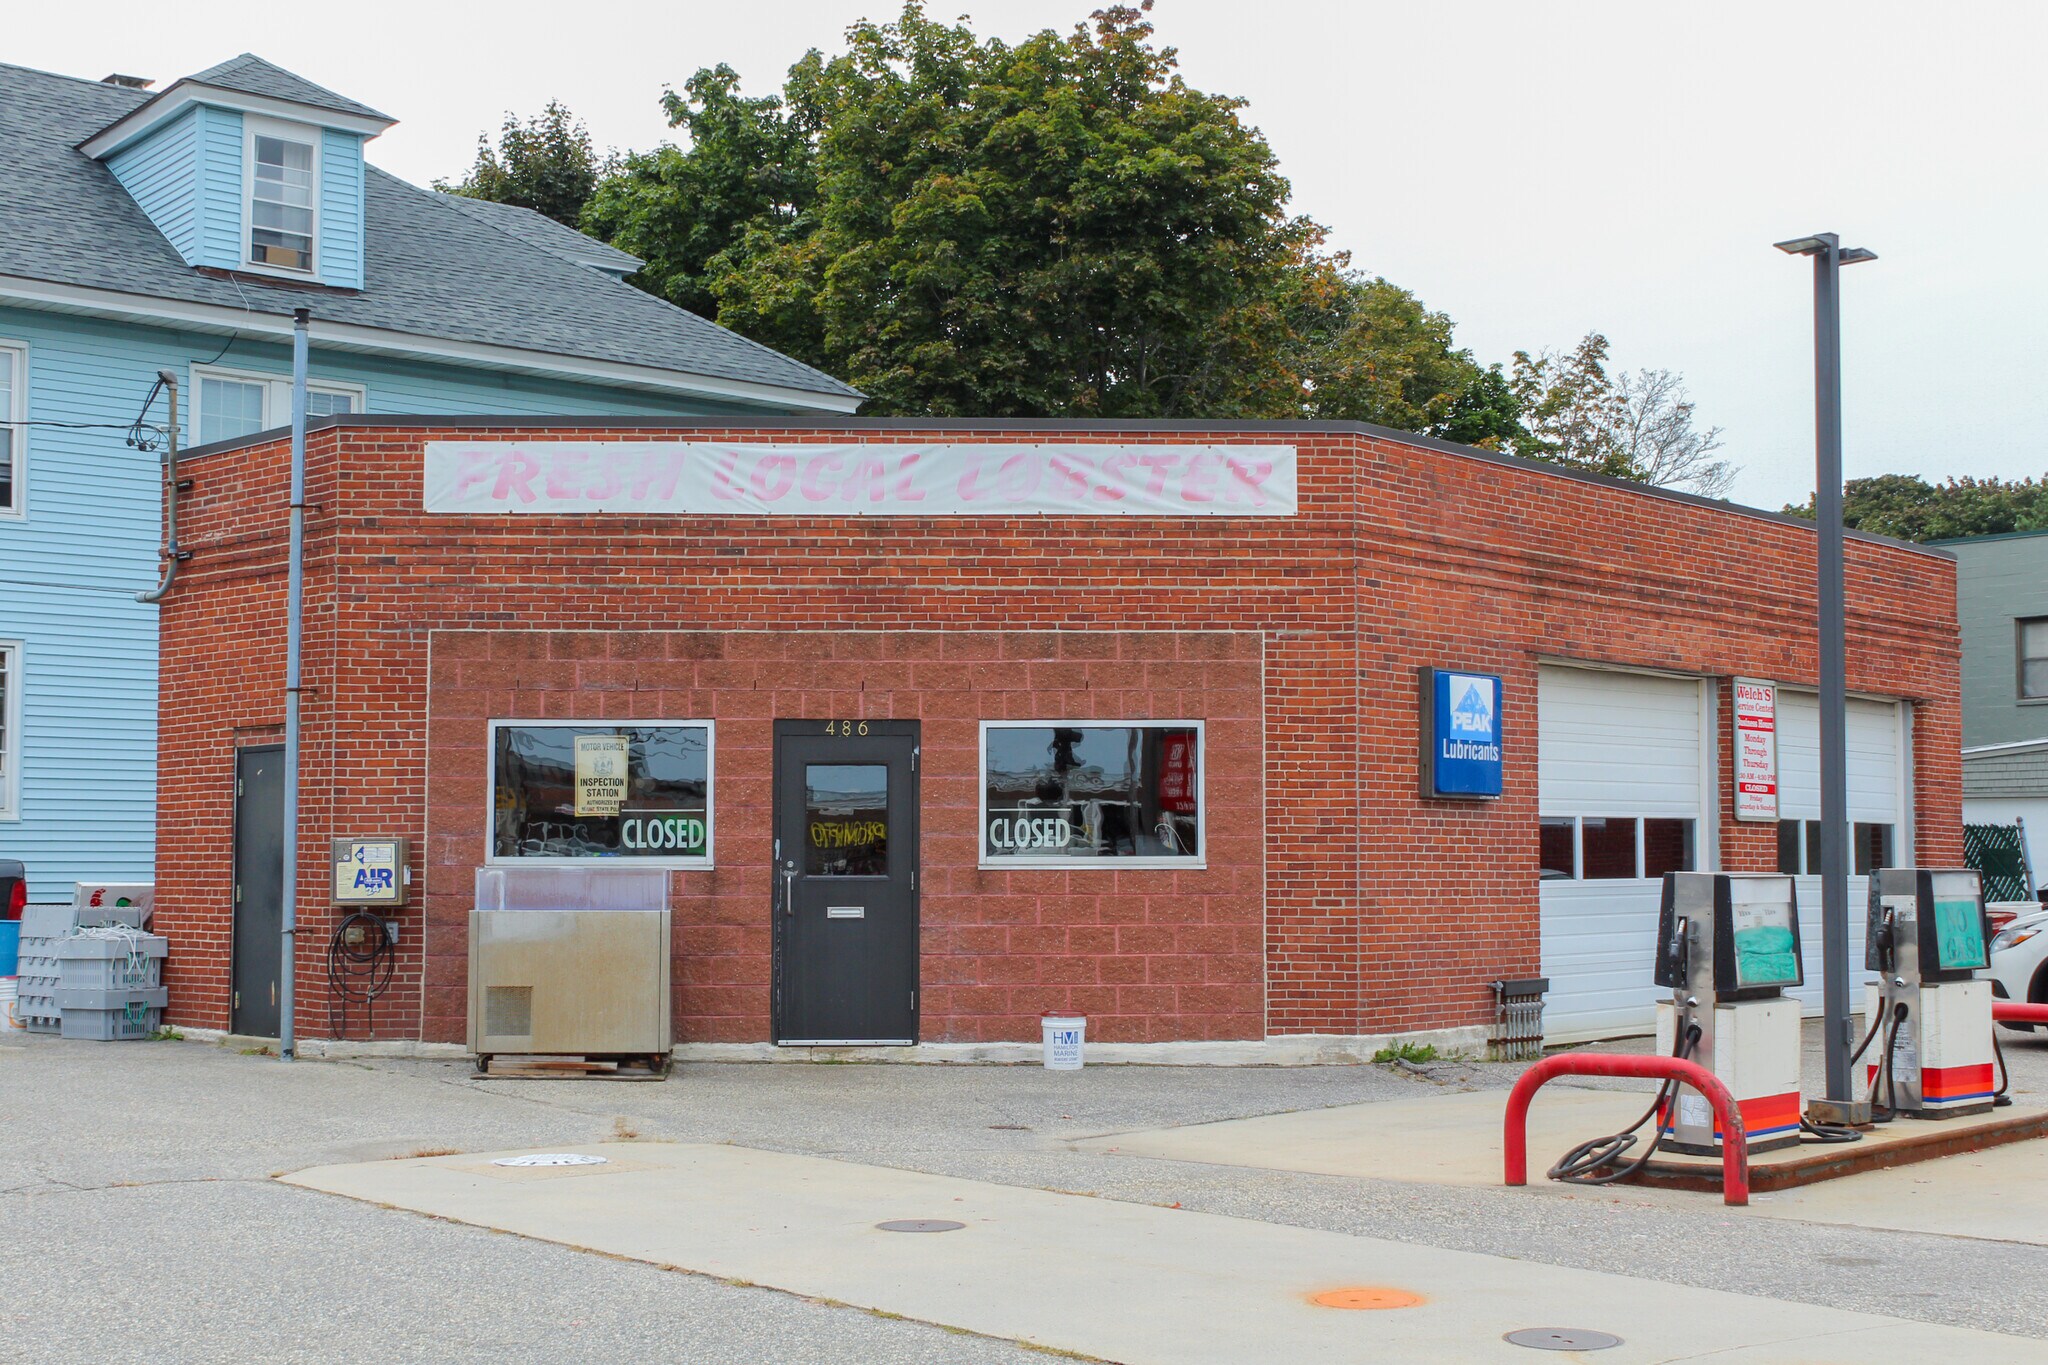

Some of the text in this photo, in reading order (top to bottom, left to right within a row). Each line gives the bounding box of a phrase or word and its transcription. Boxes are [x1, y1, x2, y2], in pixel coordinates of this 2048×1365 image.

[453, 451, 1273, 506] FRESH LOCAL LOBSTER
[1737, 702, 1755, 711] ervice
[825, 720, 868, 736] 486
[1452, 711, 1494, 732] PEAK
[580, 743, 624, 751] MOTOR VEHICLE
[1744, 733, 1766, 745] Monday
[1443, 738, 1499, 761] Lubricants
[1744, 746, 1767, 759] Through
[1743, 759, 1768, 771] Thursday
[580, 778, 625, 787] INSPECTION
[1745, 783, 1768, 792] CLOSED
[586, 788, 619, 797] STATION
[622, 819, 704, 849] CLOSED
[989, 818, 1071, 848] CLOSED
[353, 868, 393, 888] AIR
[1944, 908, 1968, 932] NO
[1947, 936, 1977, 961] GAS
